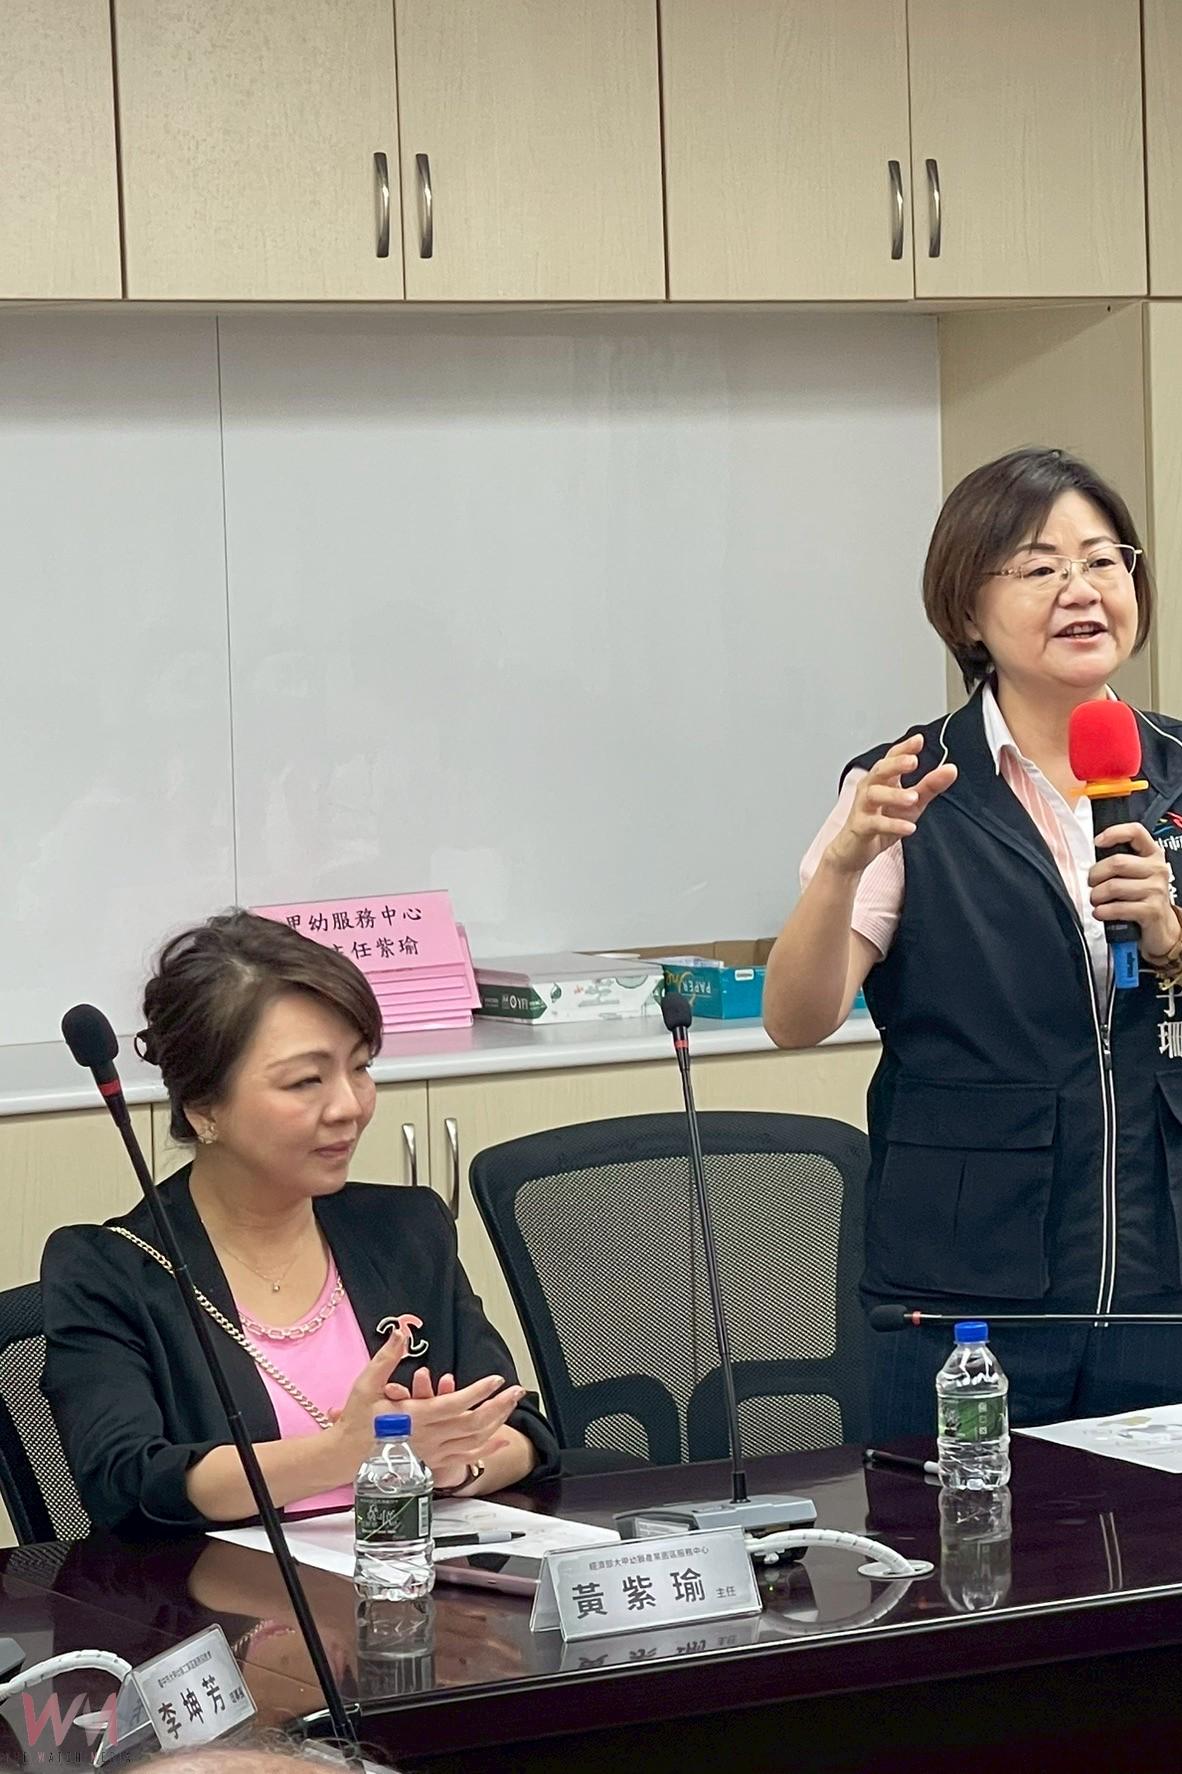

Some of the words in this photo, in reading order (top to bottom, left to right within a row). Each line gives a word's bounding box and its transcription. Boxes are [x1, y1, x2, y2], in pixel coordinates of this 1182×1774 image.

[572, 1567, 706, 1619] 黃紫瑜
[716, 1586, 737, 1599] 主任
[158, 1674, 226, 1740] 李坤芳
